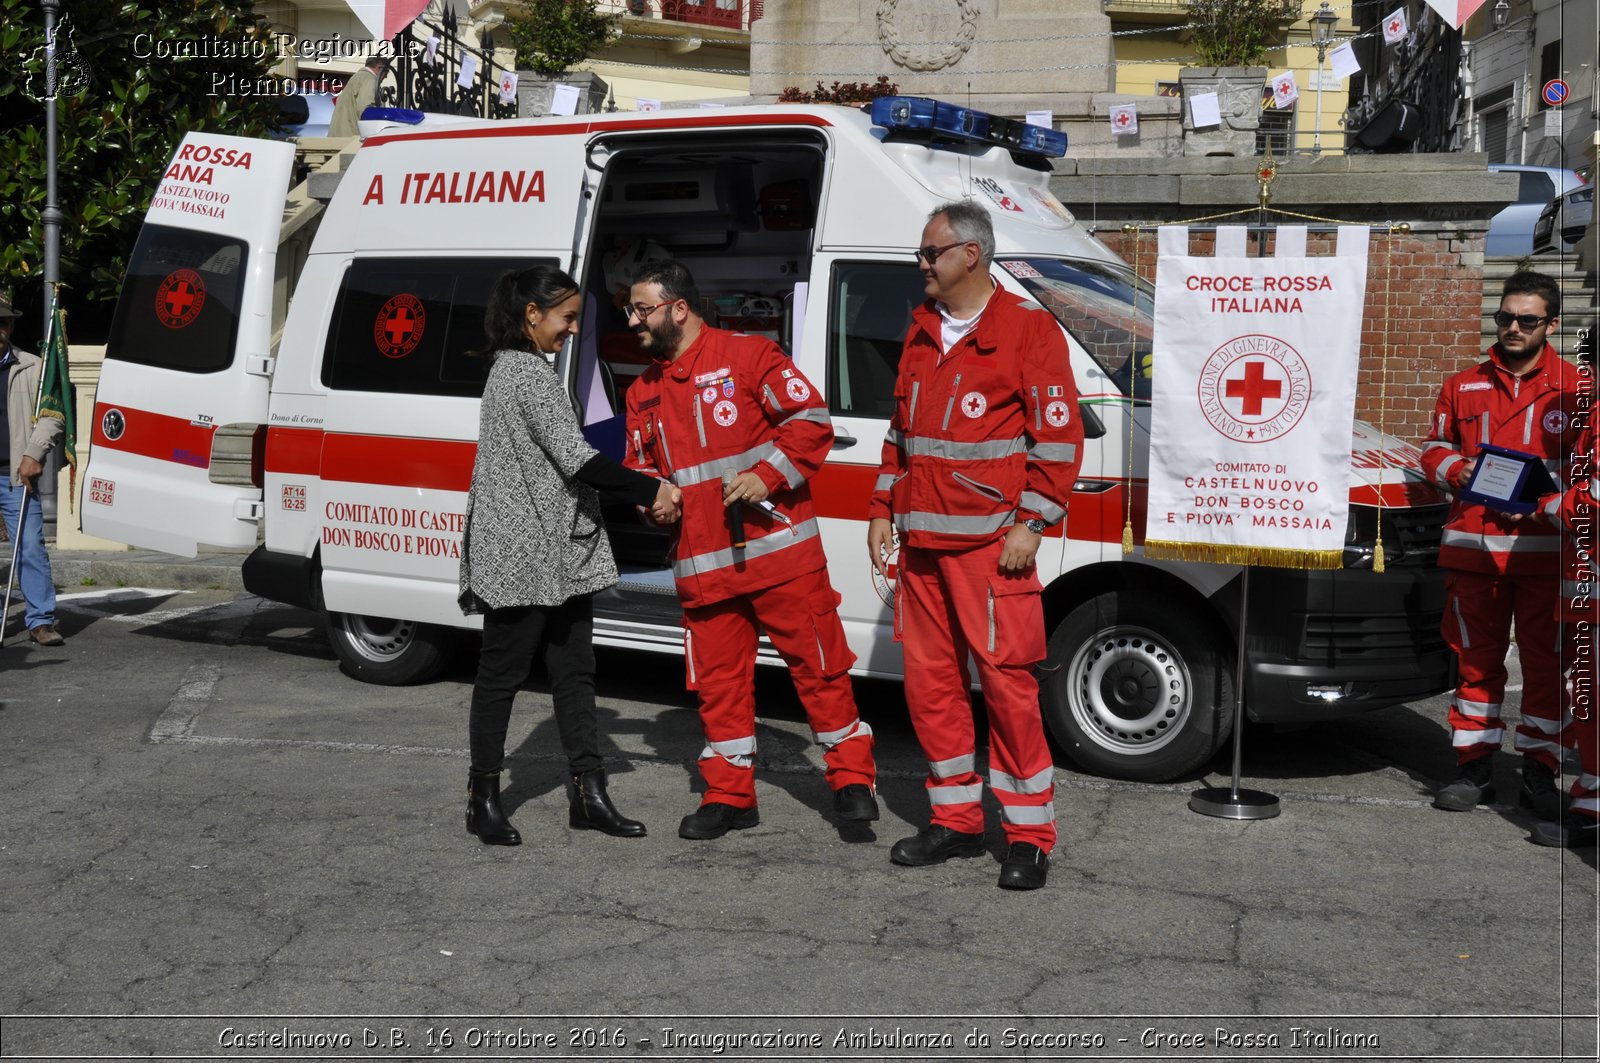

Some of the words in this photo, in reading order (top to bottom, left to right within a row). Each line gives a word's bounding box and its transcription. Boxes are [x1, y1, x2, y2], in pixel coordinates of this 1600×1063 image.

[179, 144, 252, 170] ROSSA
[362, 174, 384, 205] A
[400, 170, 546, 204] ITALIANA
[179, 201, 225, 219] MASSAIA
[1186, 275, 1253, 292] CROCE
[1263, 275, 1332, 292] ROSSA
[1211, 297, 1303, 313] ITALIANA
[1217, 347, 1234, 363] DI
[1233, 338, 1288, 361] GINEVRA
[1286, 360, 1302, 375] 22
[1201, 361, 1243, 438] CONVENZIONE
[1281, 377, 1306, 423] AGOSTO
[198, 414, 214, 423] TDI
[270, 413, 290, 422] Dono
[291, 414, 299, 423] di
[1259, 419, 1285, 438] 1864
[1215, 463, 1271, 473] COMITATO
[1275, 464, 1287, 474] DI
[92, 480, 103, 490] AT
[103, 482, 113, 492] 14
[283, 487, 293, 496] AT
[295, 488, 305, 497] 14
[1184, 477, 1318, 493] CASTELNUOVO
[90, 491, 113, 504] 12-25
[283, 499, 305, 510] 12-25
[1194, 496, 1228, 508] DON
[1240, 497, 1304, 511] BOSCO
[325, 501, 398, 527] COMITATO
[401, 509, 417, 528] DI
[1167, 512, 1175, 523] E
[1252, 515, 1332, 530] MASSAIA
[322, 526, 350, 547] DON
[354, 529, 401, 553] BOSCO
[404, 535, 413, 554] E
